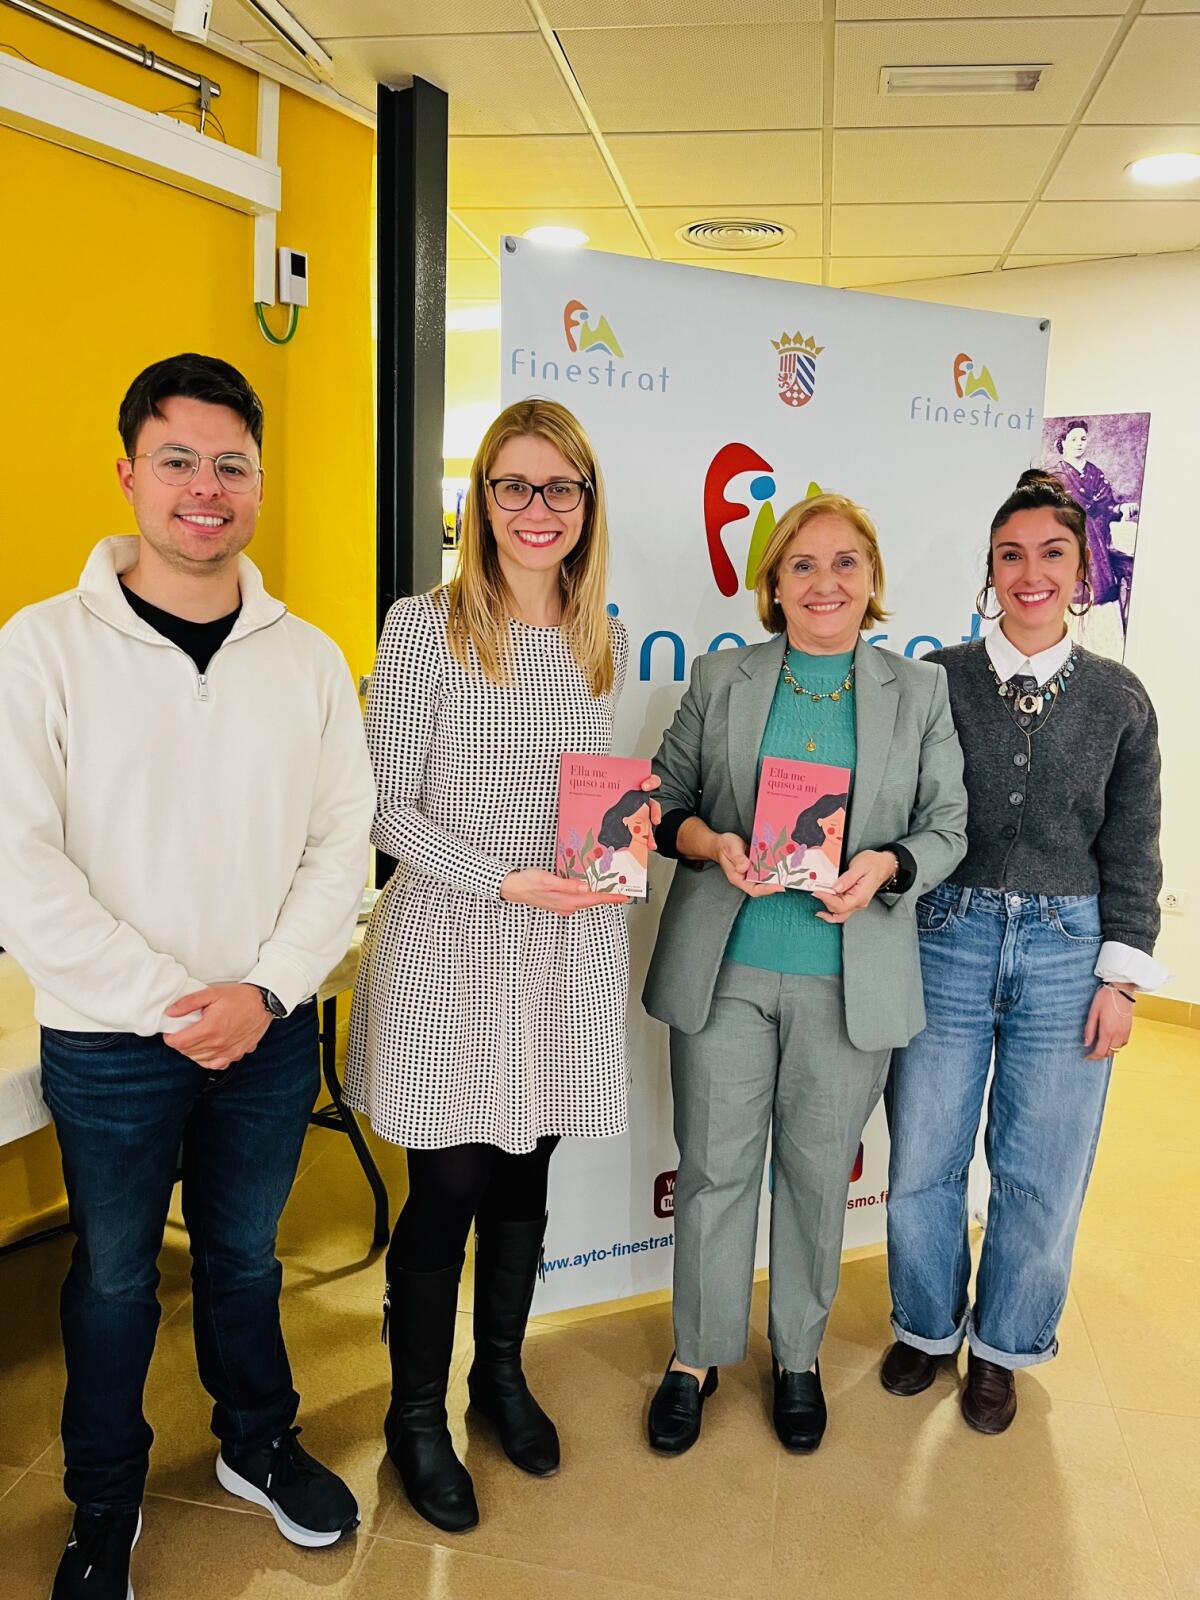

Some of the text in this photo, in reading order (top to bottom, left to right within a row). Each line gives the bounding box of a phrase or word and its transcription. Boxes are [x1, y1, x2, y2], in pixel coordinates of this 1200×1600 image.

[511, 349, 670, 393] Finestrat
[911, 396, 1035, 430] Finestrat
[570, 764, 608, 778] Ella me
[769, 767, 806, 782] Ella me
[569, 777, 597, 790] quiso
[599, 781, 606, 789] a
[767, 780, 796, 791] quiso
[543, 1233, 674, 1273] ww.ayto-finestrat
